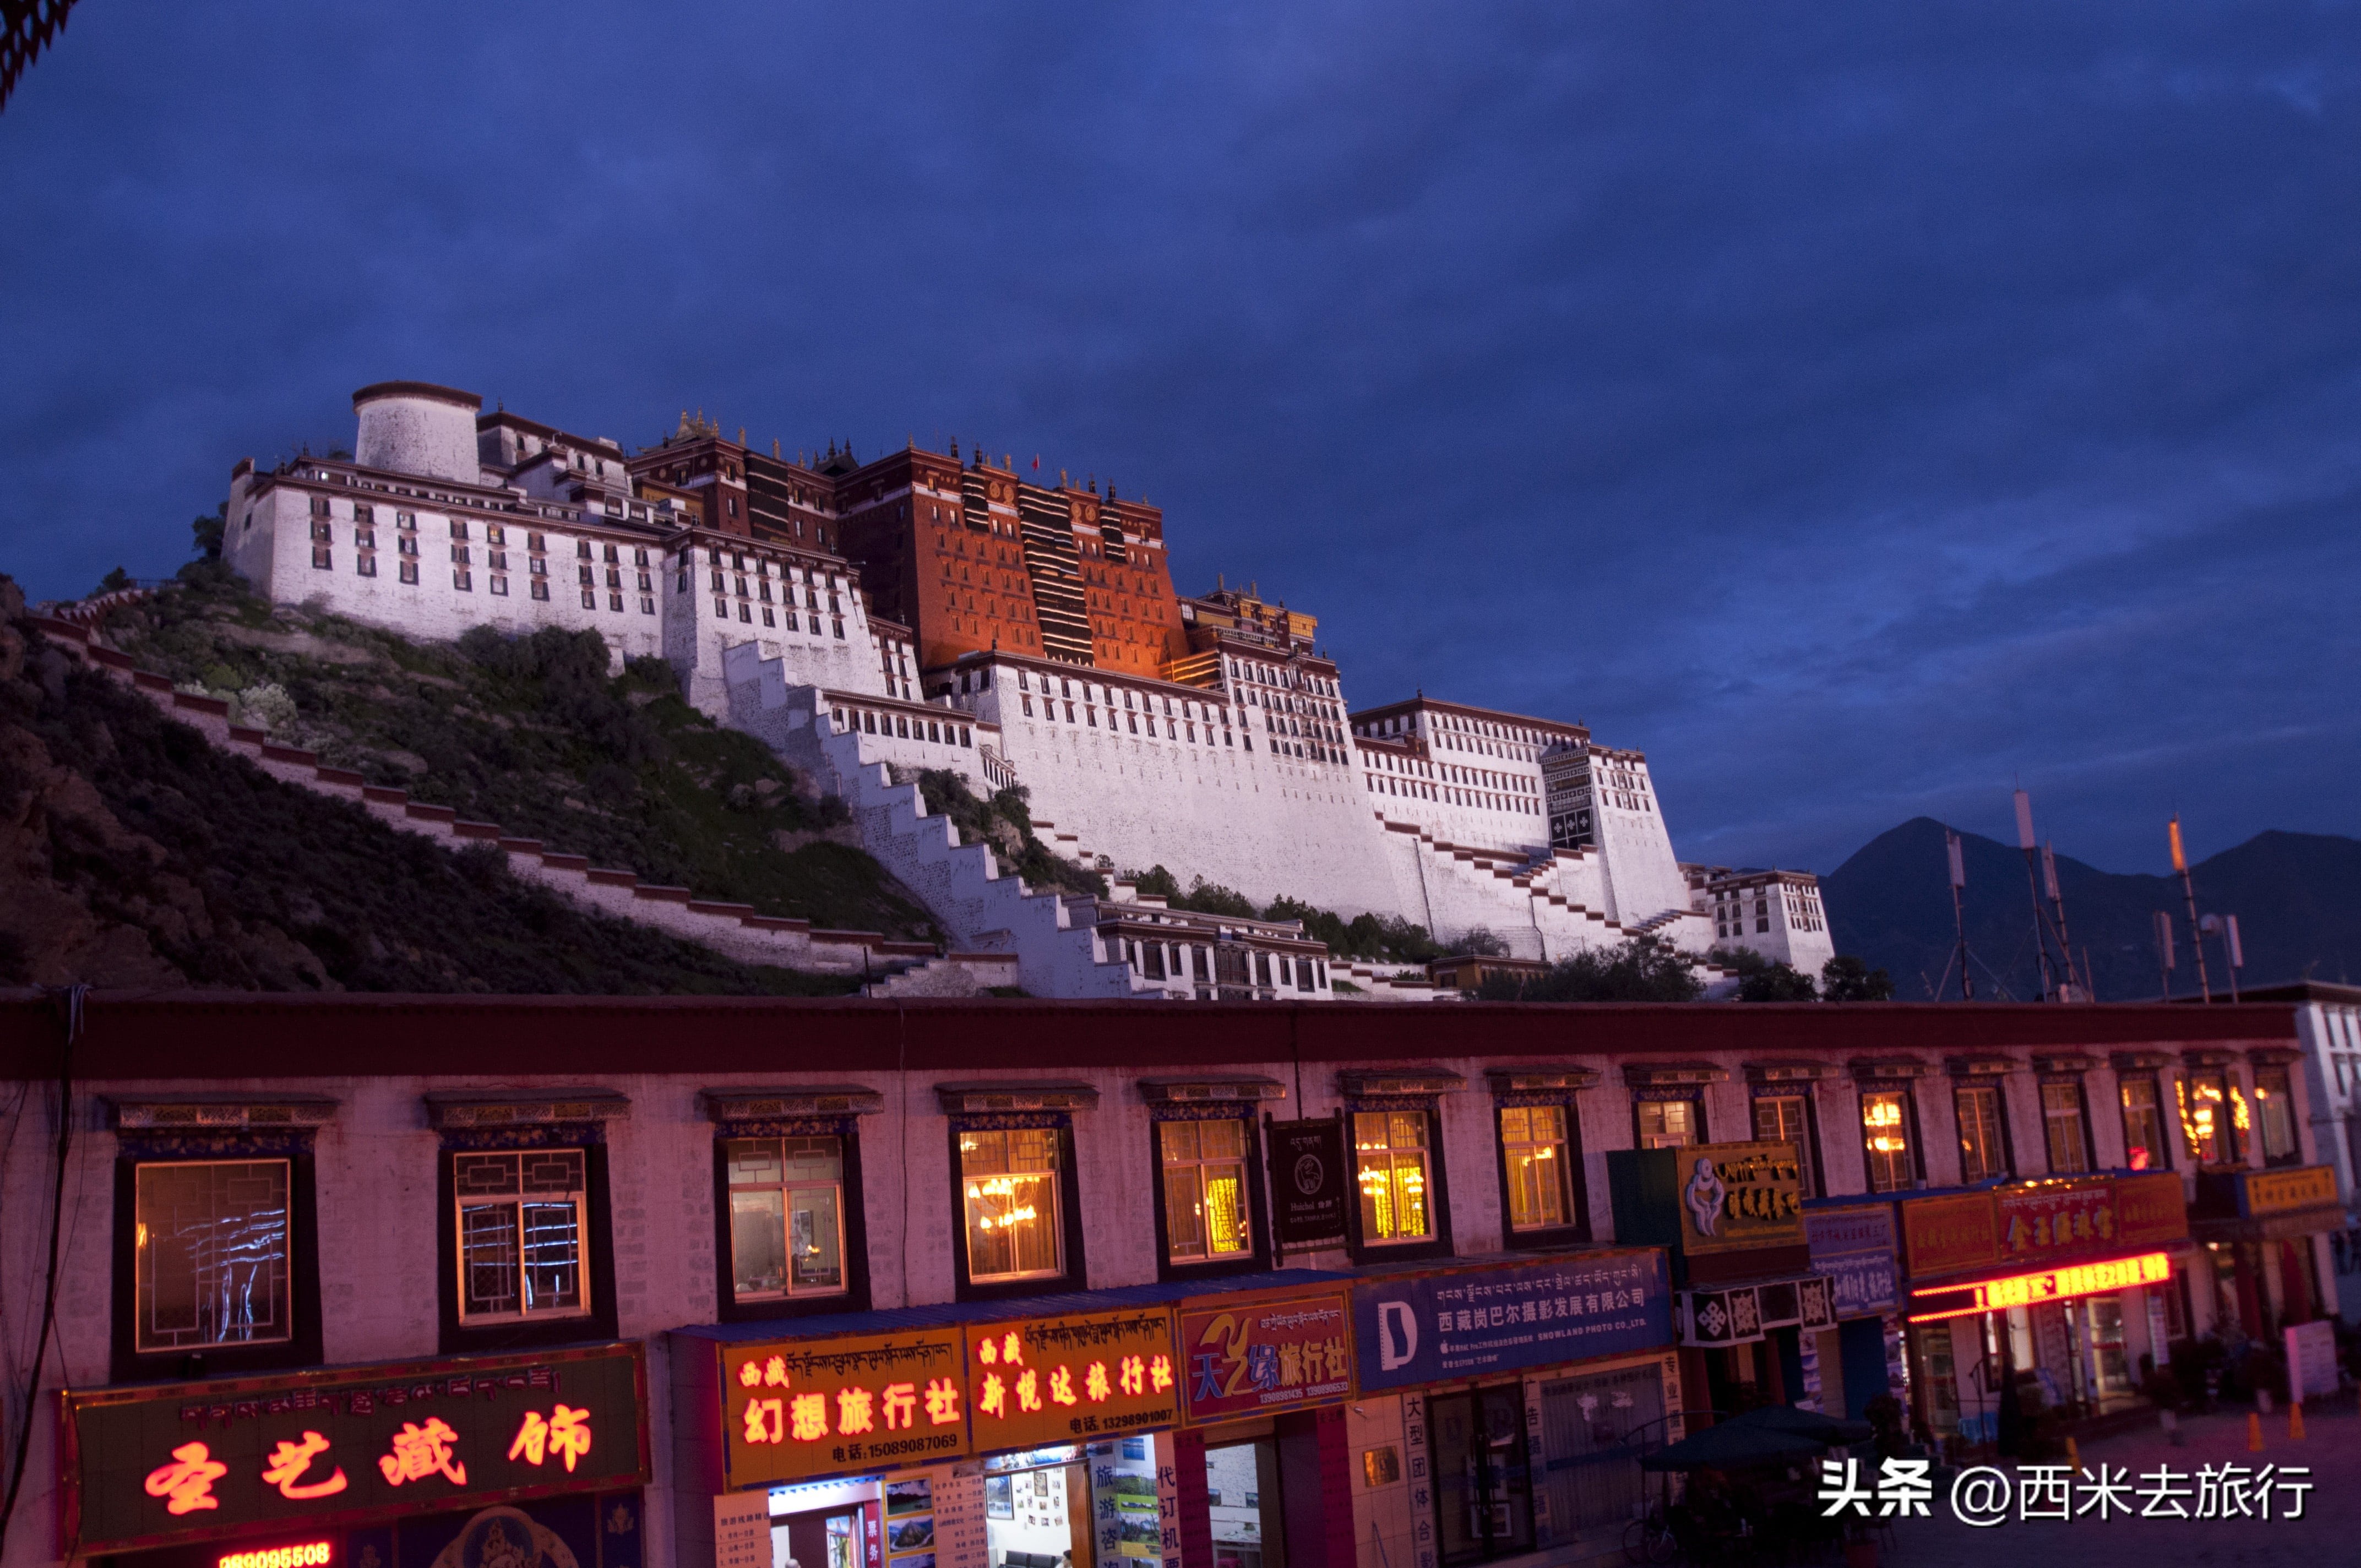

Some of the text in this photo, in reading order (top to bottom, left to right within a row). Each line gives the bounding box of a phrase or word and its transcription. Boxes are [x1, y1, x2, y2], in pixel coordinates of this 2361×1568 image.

[1437, 1288, 1645, 1332] 西藏岗巴尔摄影发展有限公司
[978, 1331, 1024, 1366] 西藏
[1537, 1327, 1584, 1341] SNOWLAND
[1586, 1323, 1612, 1334] PHOTO
[739, 1355, 790, 1389] 西藏
[979, 1354, 1174, 1419] 新悦达旅行社
[743, 1376, 960, 1444] 幻想旅行社
[1102, 1409, 1173, 1430] 13298901007
[145, 1404, 591, 1516] 圣艺藏饰
[867, 1520, 879, 1562] 票务
